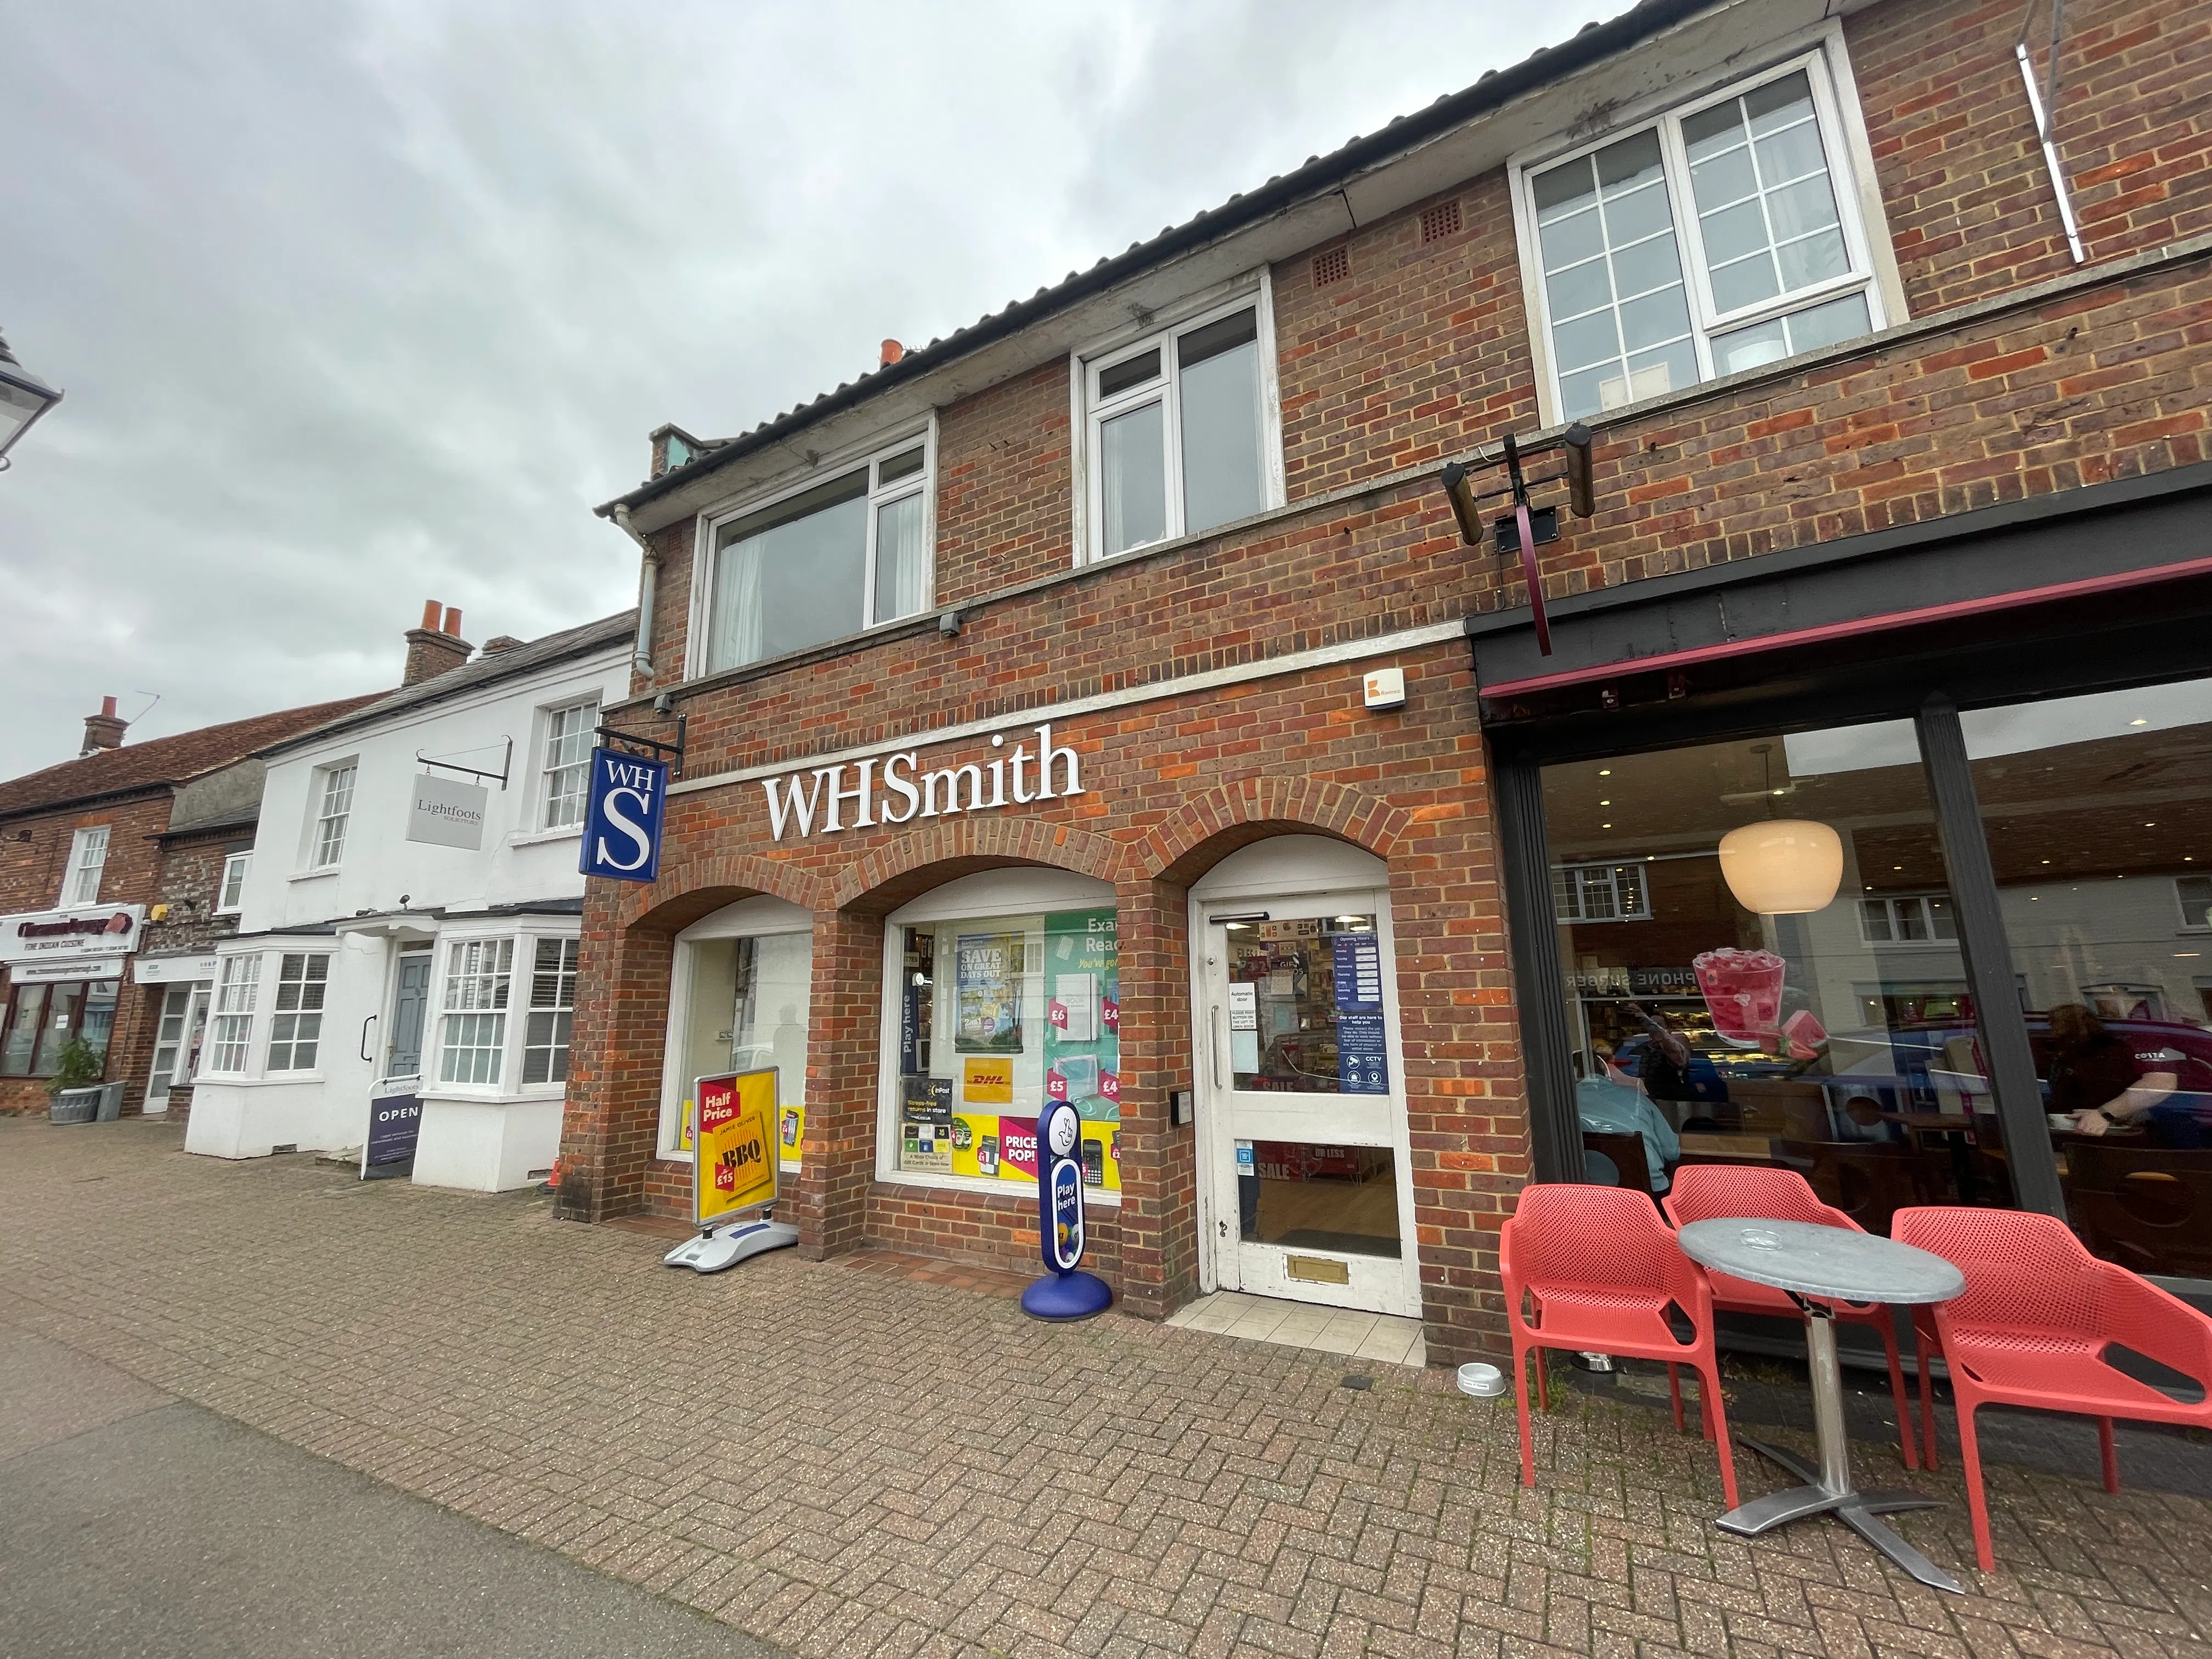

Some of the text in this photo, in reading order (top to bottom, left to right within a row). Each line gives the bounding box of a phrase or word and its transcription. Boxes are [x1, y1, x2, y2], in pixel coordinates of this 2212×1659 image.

[605, 759, 656, 791] WH
[761, 724, 1086, 842] WHSmith
[417, 799, 481, 821] Lightfoots
[443, 815, 478, 826] SOLICITORS
[596, 787, 650, 871] S
[1088, 917, 1117, 933] Exa
[961, 948, 1001, 963] SAVE
[974, 962, 1001, 970] GREAT
[1078, 958, 1104, 969] You've
[960, 969, 1001, 979] DAYS OUT
[1051, 1010, 1065, 1020] £6
[1104, 1009, 1118, 1020] £4
[904, 1025, 913, 1053] Play
[973, 1075, 1005, 1085] DHL
[1050, 1080, 1064, 1092] £5
[1103, 1081, 1118, 1092] £4
[1262, 1081, 1294, 1091] SALE
[384, 1084, 419, 1094] Lightfoots
[706, 1092, 731, 1109] Half
[379, 1106, 419, 1122] OPEN
[703, 1108, 733, 1122] Price
[719, 1116, 756, 1136] JAMIE OLIVER
[1006, 1136, 1038, 1149] PRICE
[721, 1138, 762, 1168] BBQ
[1008, 1149, 1035, 1162] POP!
[1327, 1148, 1345, 1158] LESS
[1257, 1163, 1290, 1180] SALE
[716, 1172, 733, 1186] £15
[1057, 1183, 1075, 1198] Play
[1058, 1195, 1076, 1211] here
